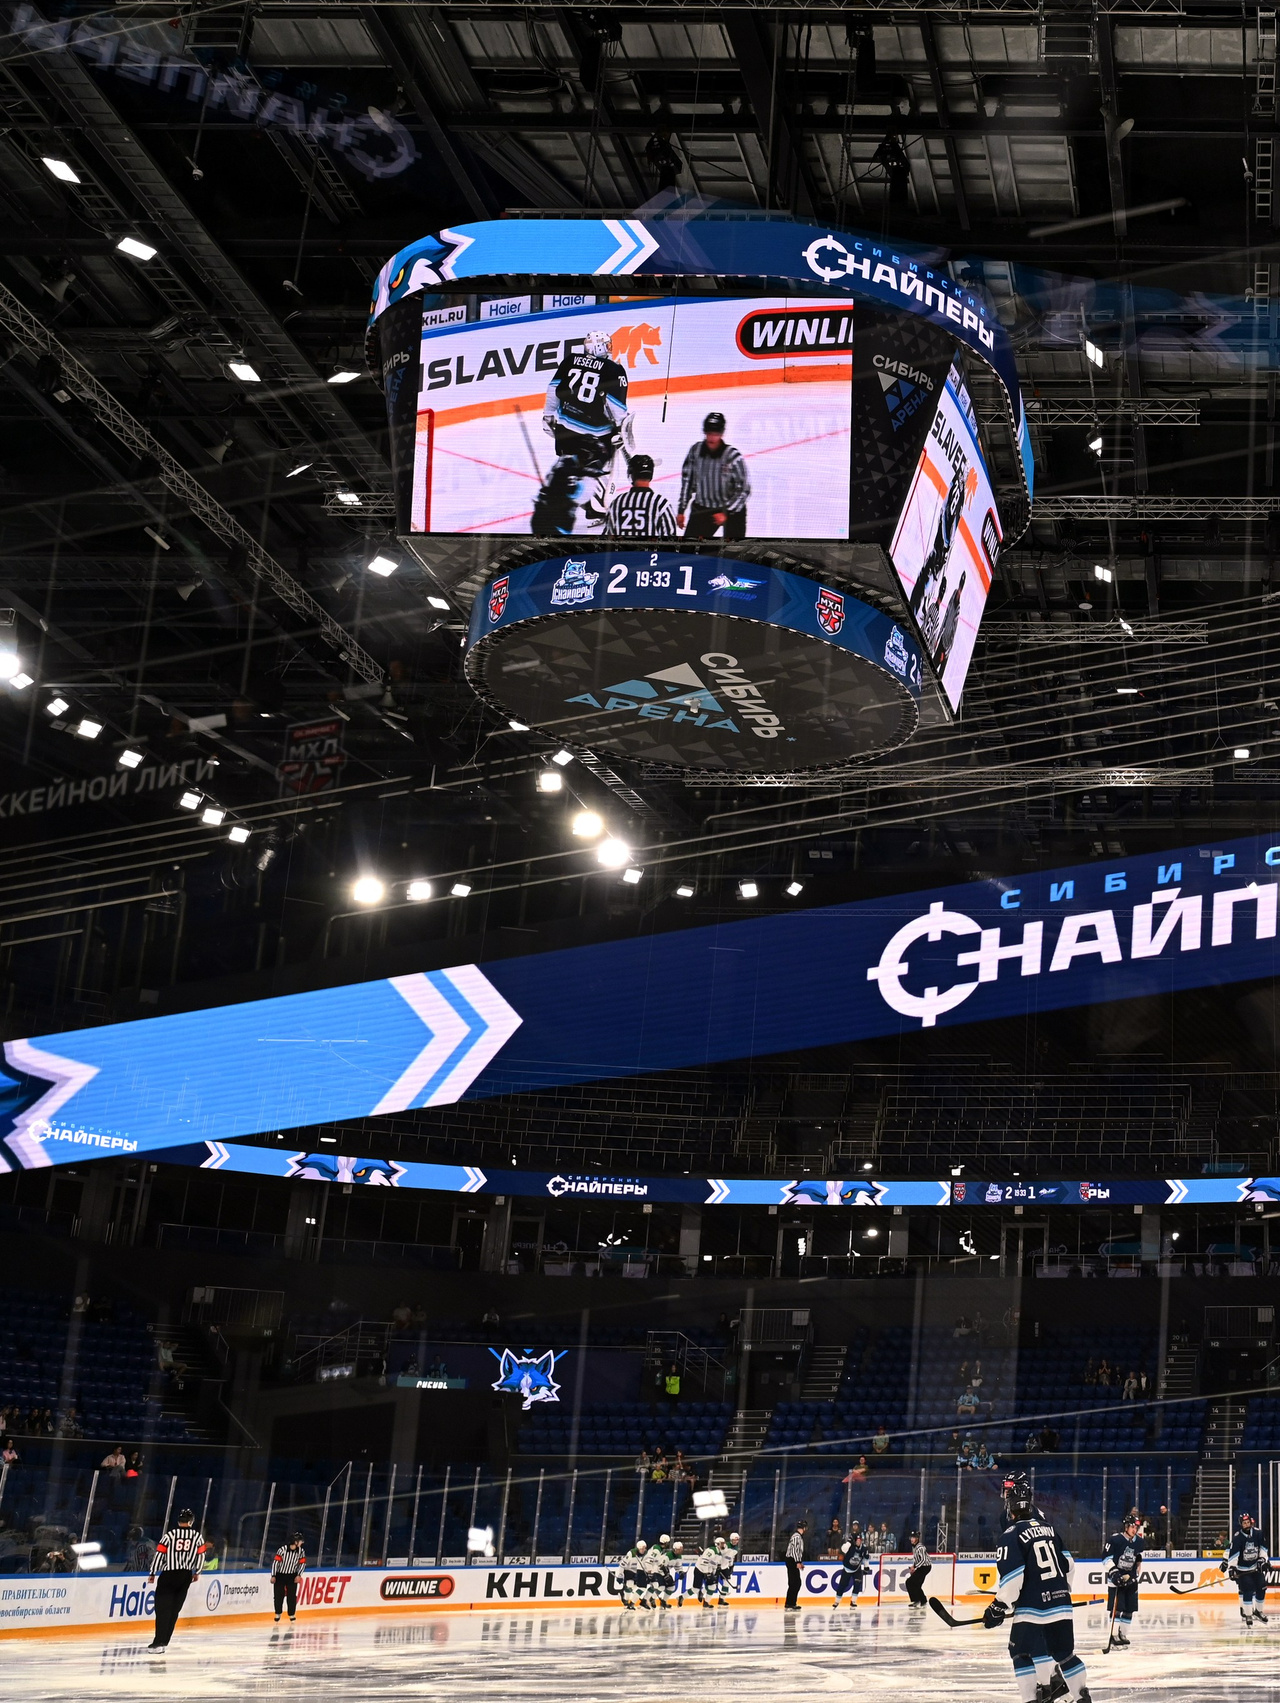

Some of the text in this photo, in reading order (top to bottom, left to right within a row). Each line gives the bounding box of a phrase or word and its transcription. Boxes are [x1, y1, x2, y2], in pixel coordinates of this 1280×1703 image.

[854, 241, 986, 317] СИБИРСКИЕ
[802, 235, 995, 351] СНАЙПЕРЫ
[422, 310, 464, 326] KHL.RU
[489, 301, 522, 317] Haier
[573, 355, 604, 370] VESELOV
[617, 375, 628, 388] 78
[872, 354, 935, 393] СИБИРЬ
[567, 368, 600, 404] 78
[890, 390, 929, 433] АРЕНА
[621, 509, 646, 530] 25
[650, 553, 658, 567] 2
[607, 564, 698, 596] 2 19:33 1
[820, 597, 841, 612] МХЛ
[700, 652, 785, 739] СИБИРЬ
[563, 692, 740, 733] АРЕНА
[289, 739, 339, 761] МХЛ
[134, 757, 216, 795] ЛИГИ
[27, 1118, 138, 1152] СНАЙПЕРЫ
[546, 1175, 648, 1198] СНАЙПЕРЫ
[175, 1539, 191, 1551] 68
[997, 1546, 1009, 1561] 91
[571, 1556, 598, 1564] ULANTA
[742, 1554, 769, 1562] ULANTA
[1033, 1540, 1064, 1581] 91
[2, 1588, 67, 1600] ПРАВИТЕЛЬСТВО
[223, 1584, 259, 1597] Платосфера
[384, 1580, 438, 1596] WINLINE
[486, 1570, 625, 1598] KHL.RU
[44, 1604, 71, 1615] области
[109, 1582, 156, 1618] Haie
